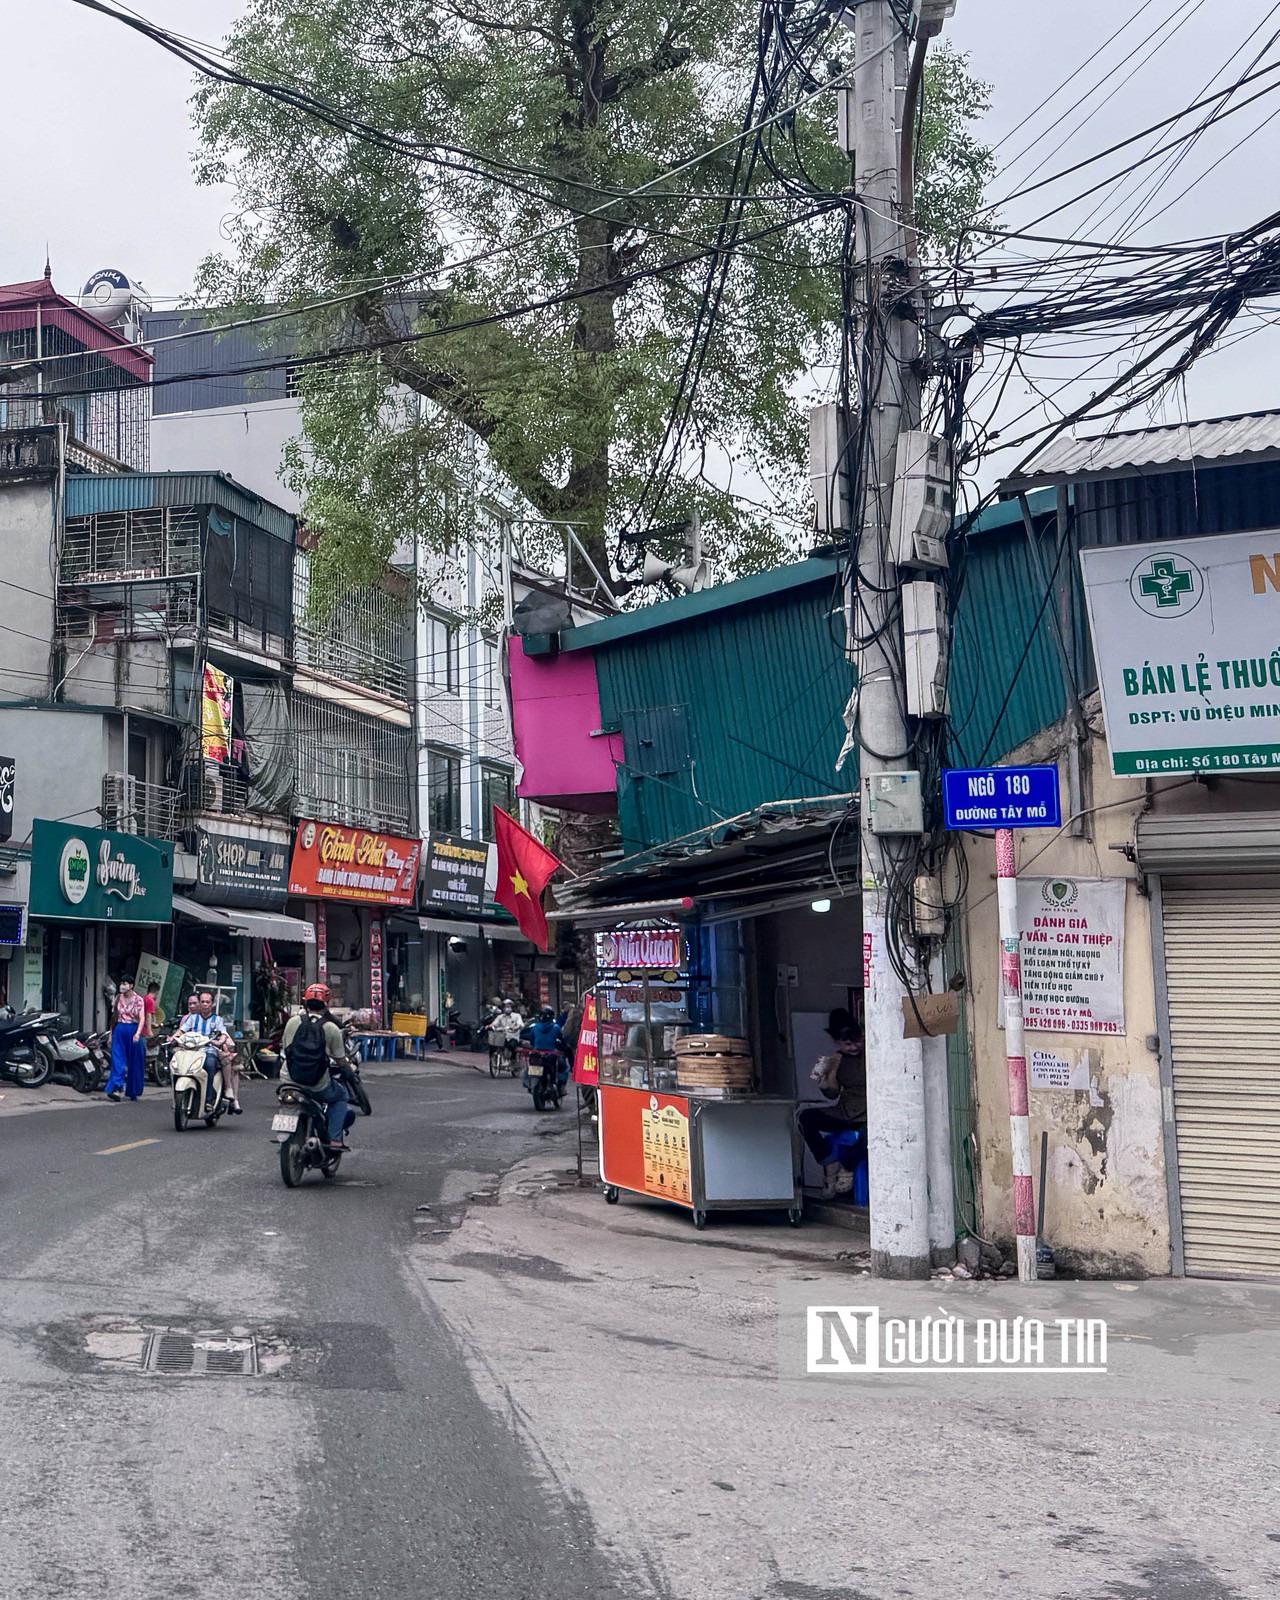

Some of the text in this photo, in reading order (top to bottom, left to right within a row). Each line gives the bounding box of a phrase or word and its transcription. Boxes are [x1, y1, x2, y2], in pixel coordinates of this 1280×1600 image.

[1123, 652, 1211, 696] BÁN LẺ
[1129, 711, 1175, 725] DSPT:
[1179, 707, 1201, 721] VŨ
[1206, 705, 1245, 722] DIỆU
[1136, 753, 1267, 772] Địa Số 180 Tây
[968, 772, 1030, 797] NGÕ 180
[955, 800, 1047, 820] ĐƯỜNG TÂY MỖ
[217, 840, 245, 868] SHOP
[1033, 915, 1088, 929] ĐÁNH GIÁ
[1026, 928, 1113, 948] VẤN CAN THIỆP
